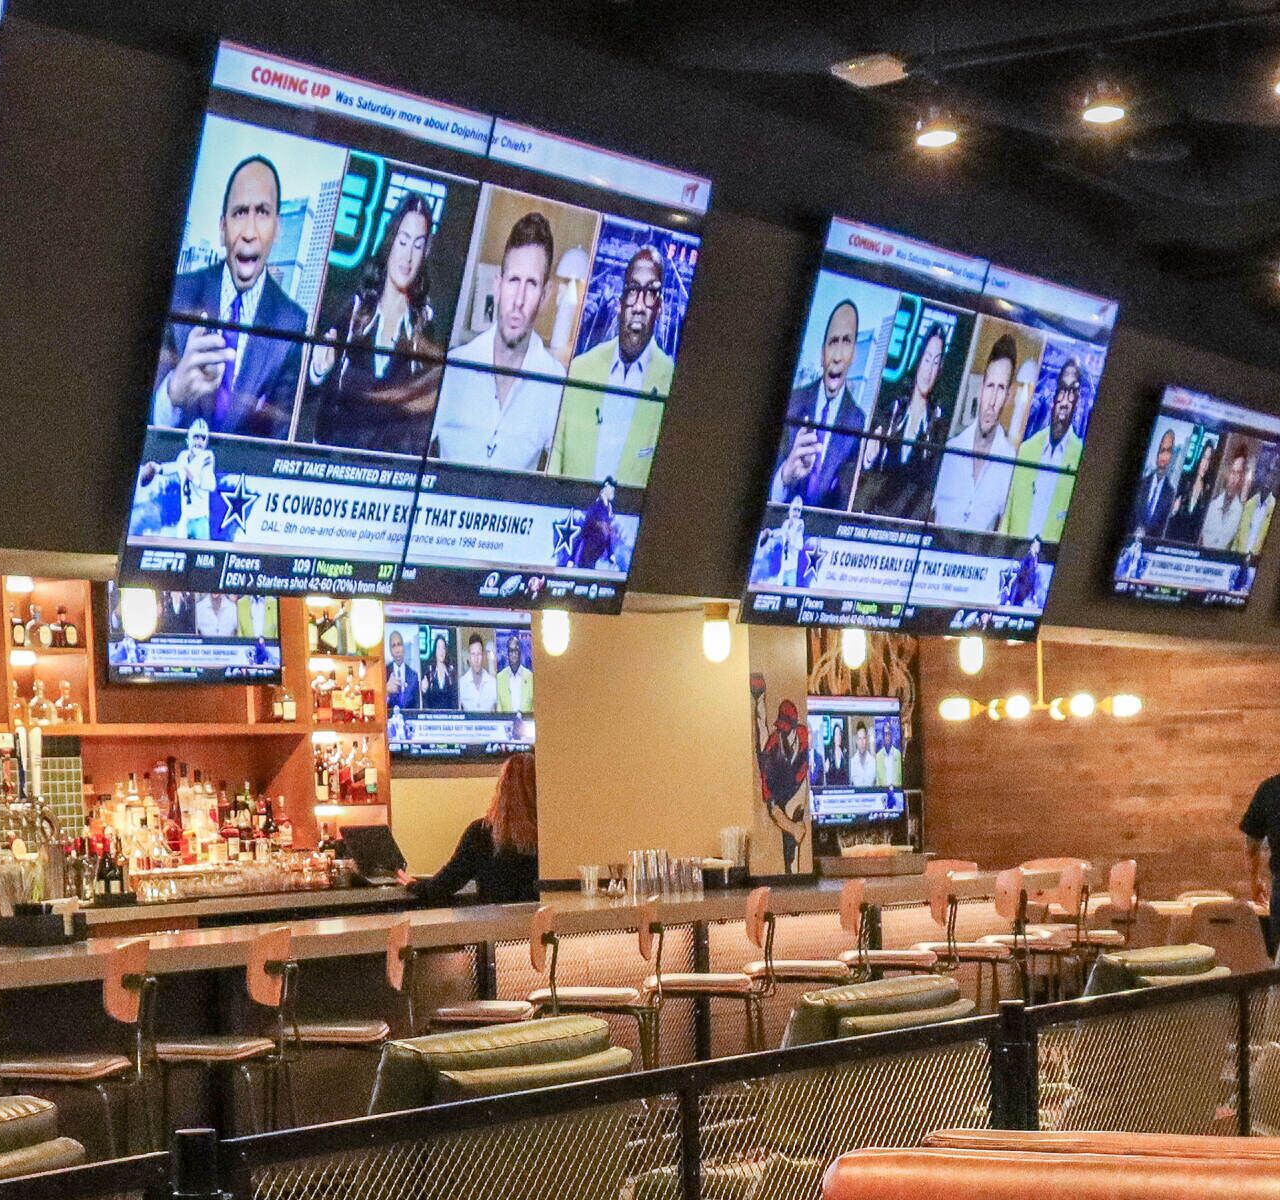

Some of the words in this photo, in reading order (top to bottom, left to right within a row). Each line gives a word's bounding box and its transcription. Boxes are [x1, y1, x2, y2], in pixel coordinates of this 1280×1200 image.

[251, 66, 309, 95] COMING
[311, 82, 331, 99] UP
[336, 90, 353, 106] Was
[357, 96, 397, 120] Saturday
[398, 111, 421, 124] more
[424, 117, 449, 131] about
[451, 123, 488, 143] Dolphins
[501, 135, 533, 153] Chiefs?
[273, 458, 301, 474] FIRST
[303, 461, 326, 477] TAKE
[326, 464, 379, 482] PRESENTED
[379, 470, 392, 484] BY
[392, 471, 416, 487] ESPN
[265, 492, 279, 512] IS
[282, 494, 348, 518] COWBOYS
[350, 501, 391, 523] EARLY
[425, 507, 457, 528] THAT
[458, 510, 534, 535] SURPRISING?
[358, 528, 386, 544] playoff
[140, 550, 187, 572] ESPN
[195, 554, 215, 568] NBA
[228, 555, 260, 570] Pacers
[292, 559, 311, 574] 109
[317, 560, 353, 577] Nuggets
[378, 564, 394, 578] 117
[830, 550, 838, 565] IS
[840, 552, 878, 570] COWBOYS
[880, 556, 903, 572] EARLY
[922, 561, 942, 576] THAT
[226, 573, 246, 586] DEN
[256, 574, 289, 588] Starters
[289, 577, 308, 590] shot
[308, 578, 333, 591] 42-60
[358, 580, 376, 593] from
